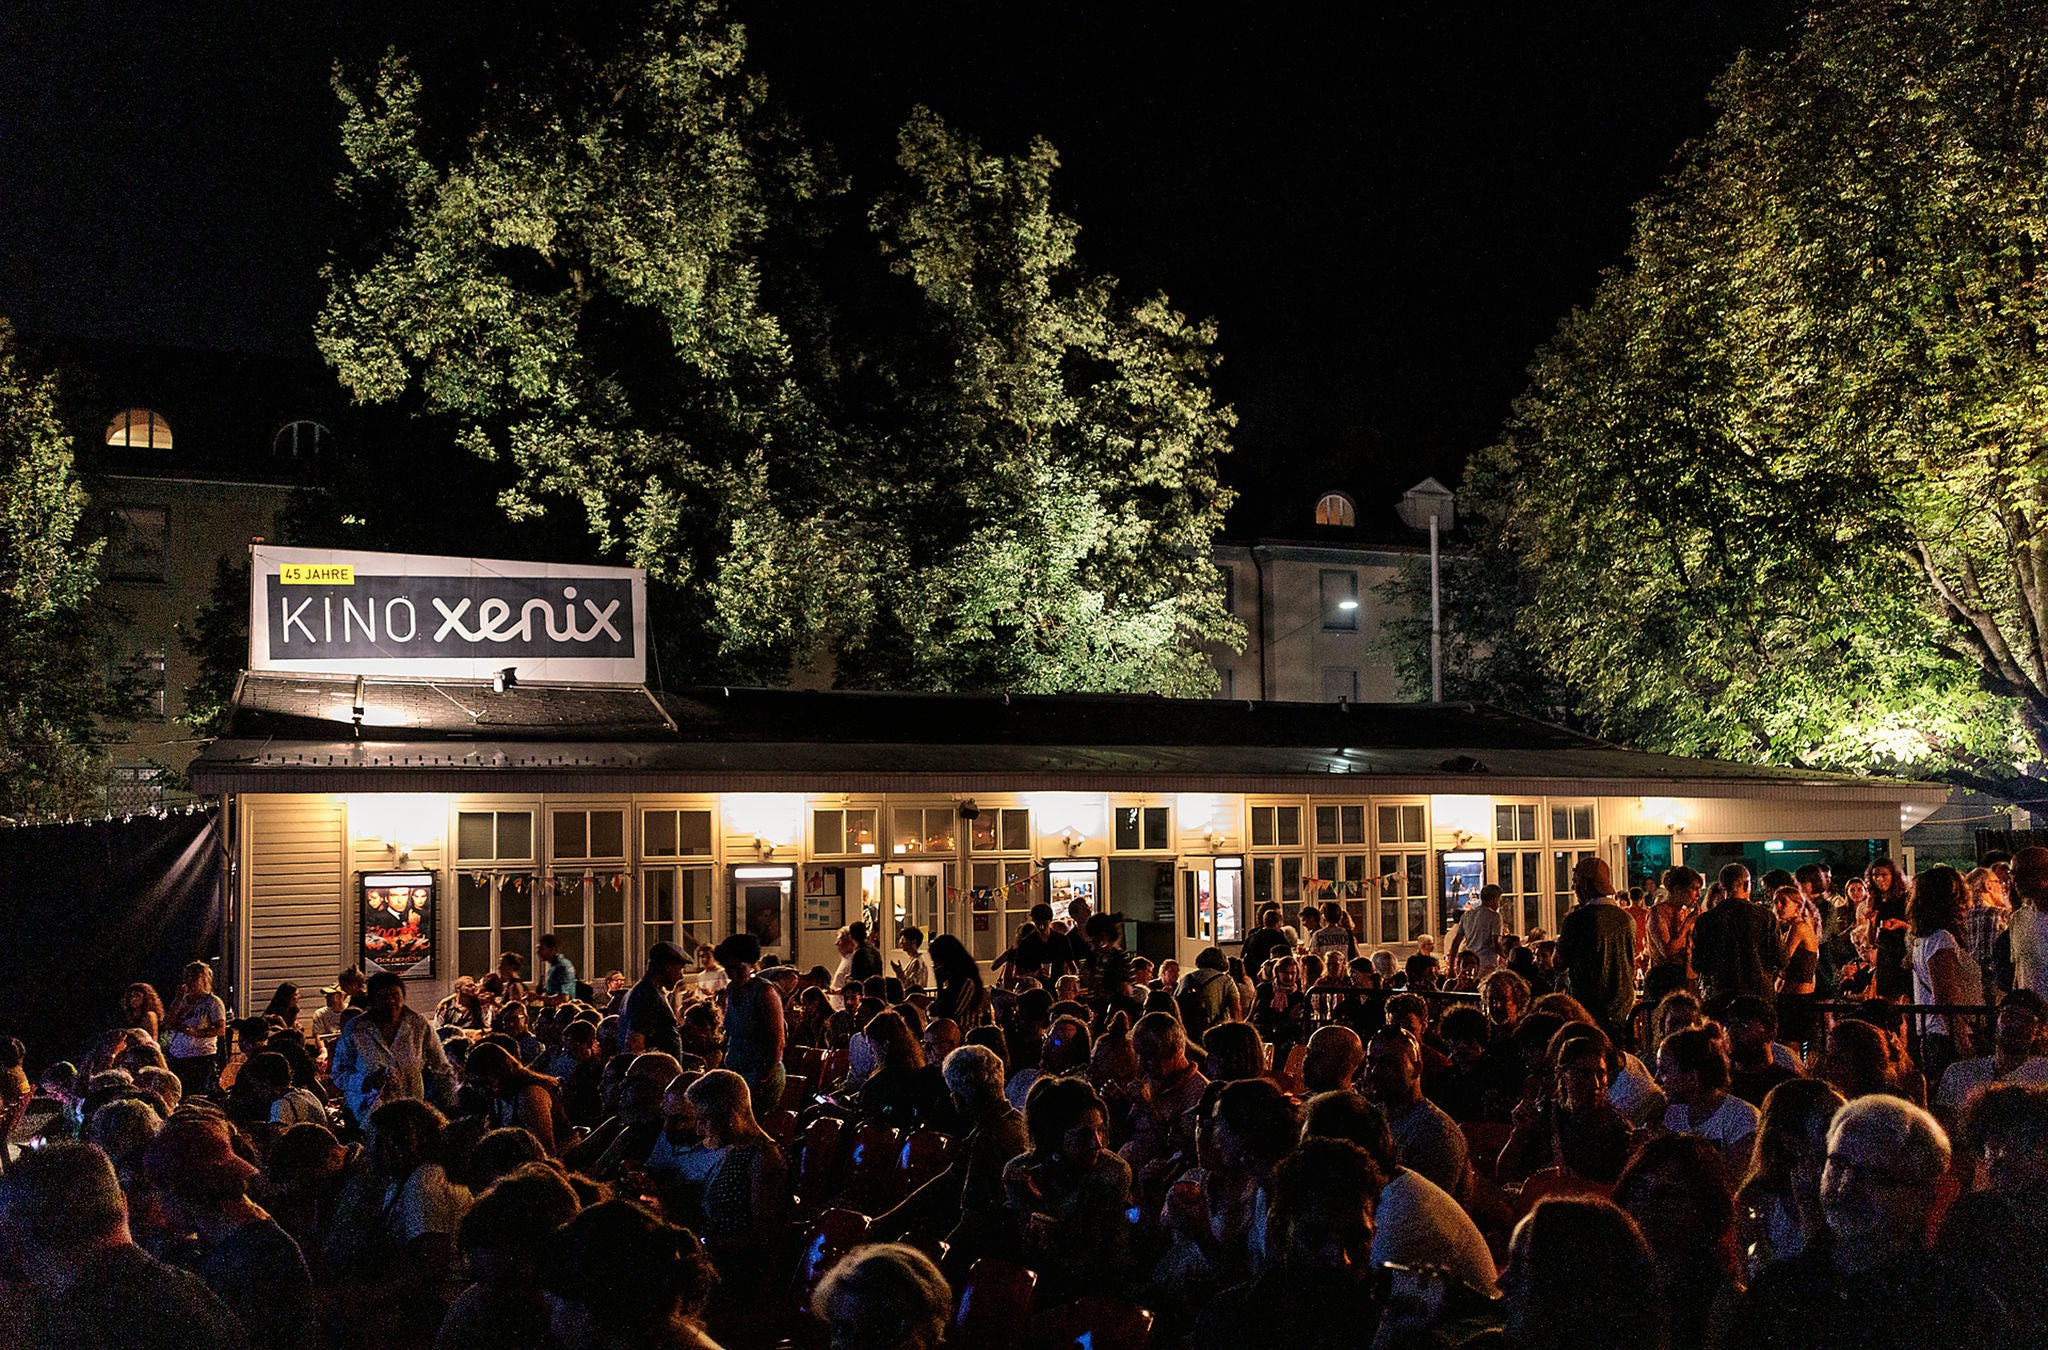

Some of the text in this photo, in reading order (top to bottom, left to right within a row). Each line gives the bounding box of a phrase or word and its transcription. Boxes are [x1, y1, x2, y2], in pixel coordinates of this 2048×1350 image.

[285, 568, 349, 580] 45 JAHRE
[282, 586, 622, 643] KINO xenix
